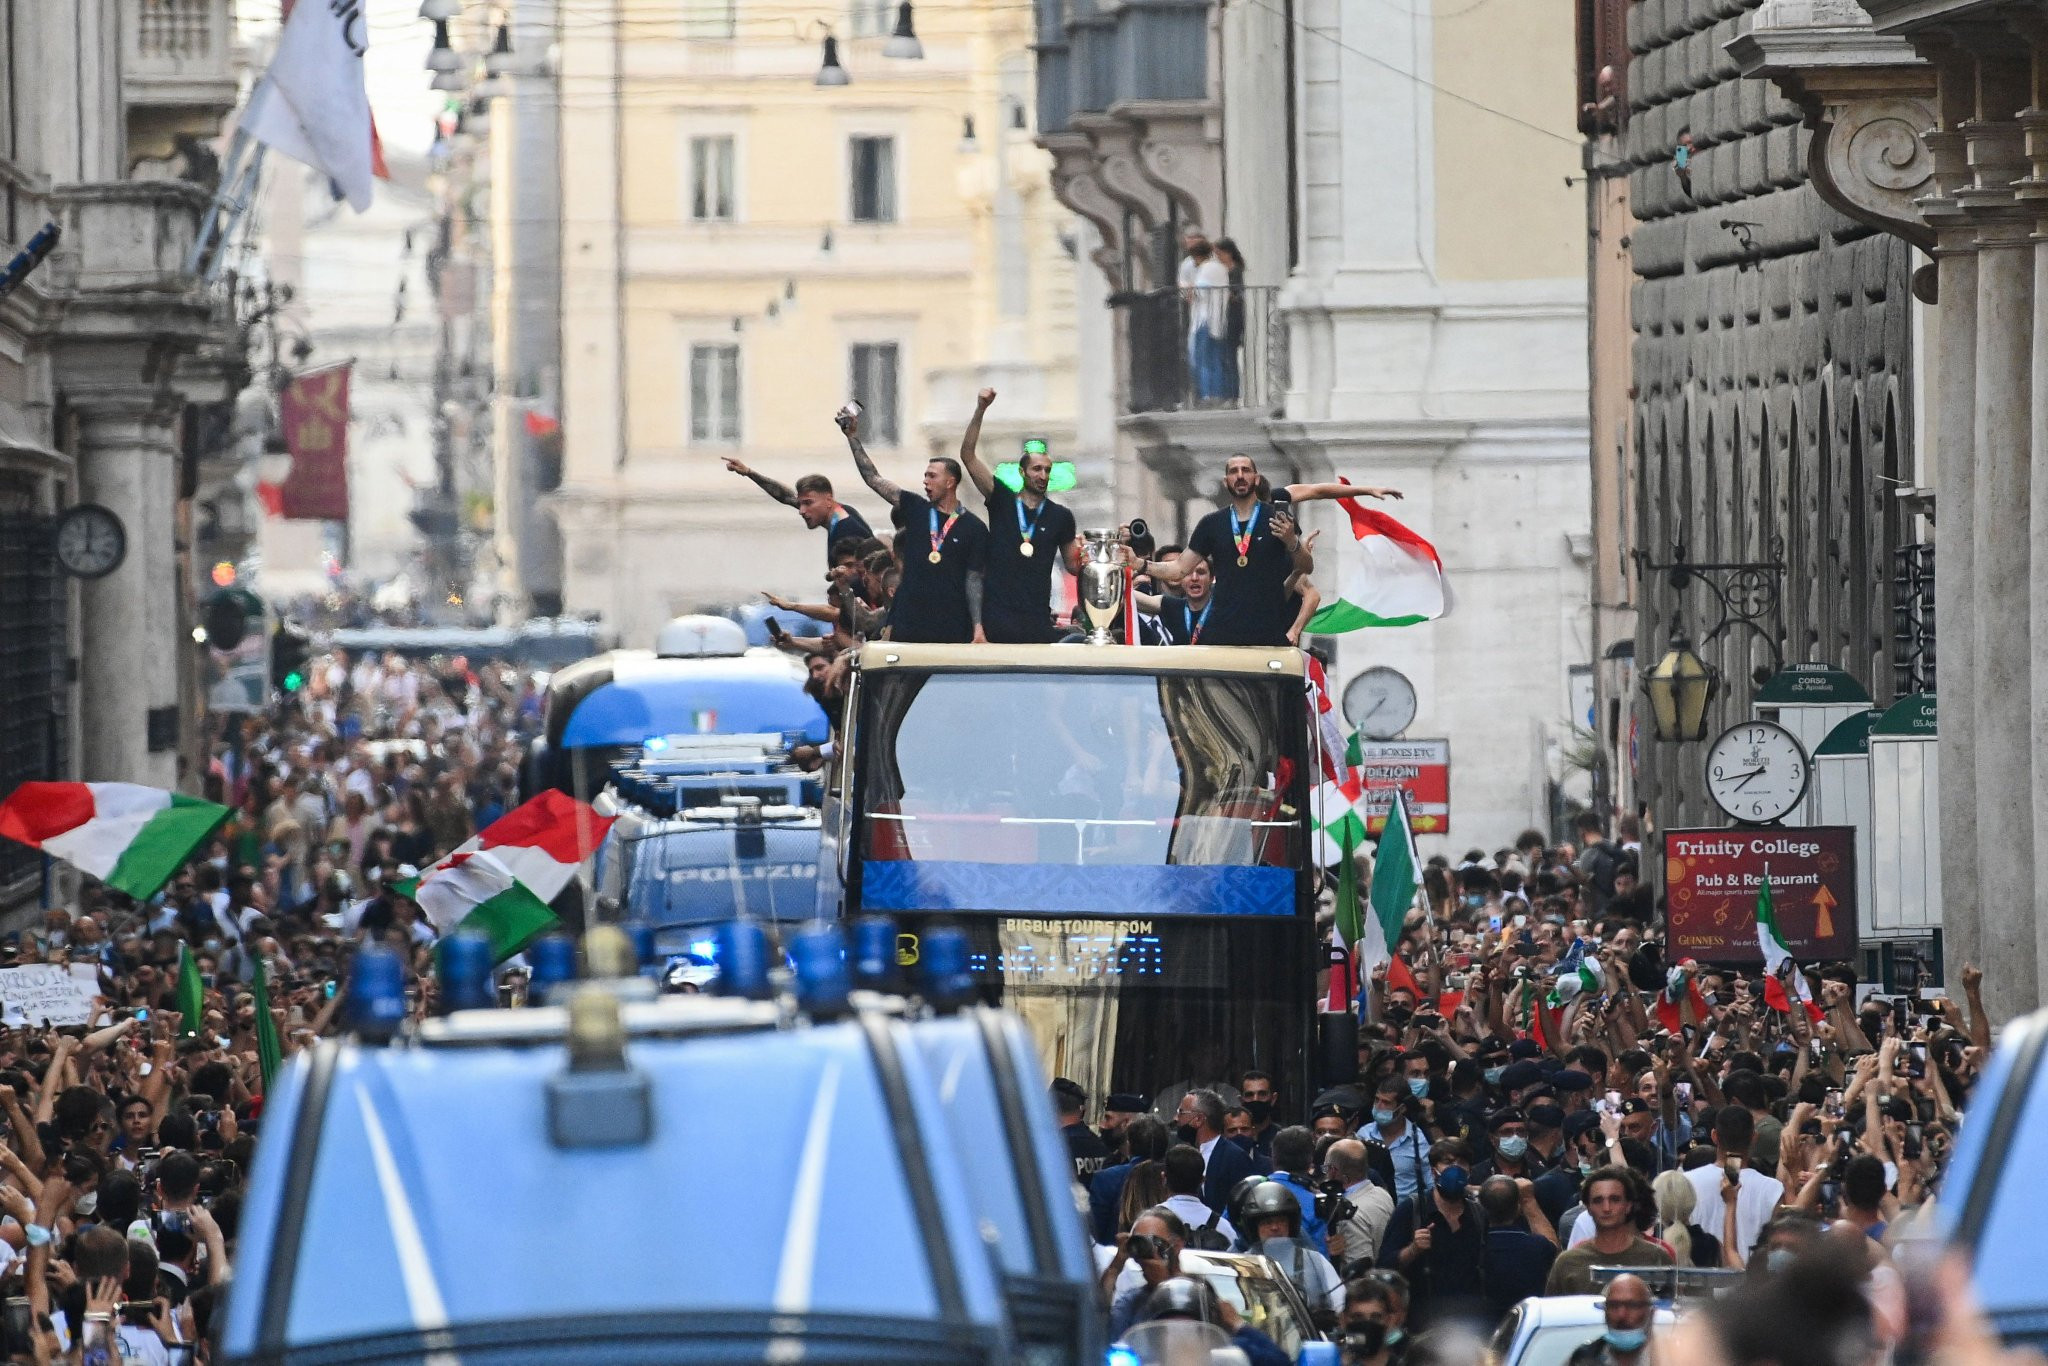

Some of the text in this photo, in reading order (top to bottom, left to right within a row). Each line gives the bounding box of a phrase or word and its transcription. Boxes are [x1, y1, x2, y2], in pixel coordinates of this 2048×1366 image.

[1796, 663, 1829, 671] FERMATA
[1798, 677, 1827, 685] CORSO
[1920, 705, 1938, 716] Cor
[1748, 728, 1766, 744] 12
[1713, 765, 1724, 781] 9
[1790, 763, 1800, 780] 3
[1752, 799, 1763, 816] 6
[1677, 839, 1820, 858] Trinity College
[1696, 874, 1723, 887] Pub
[1726, 874, 1740, 886] &
[1006, 919, 1153, 935] BIGBUSTOURS.COM
[1678, 935, 1725, 946] GUINNESS
